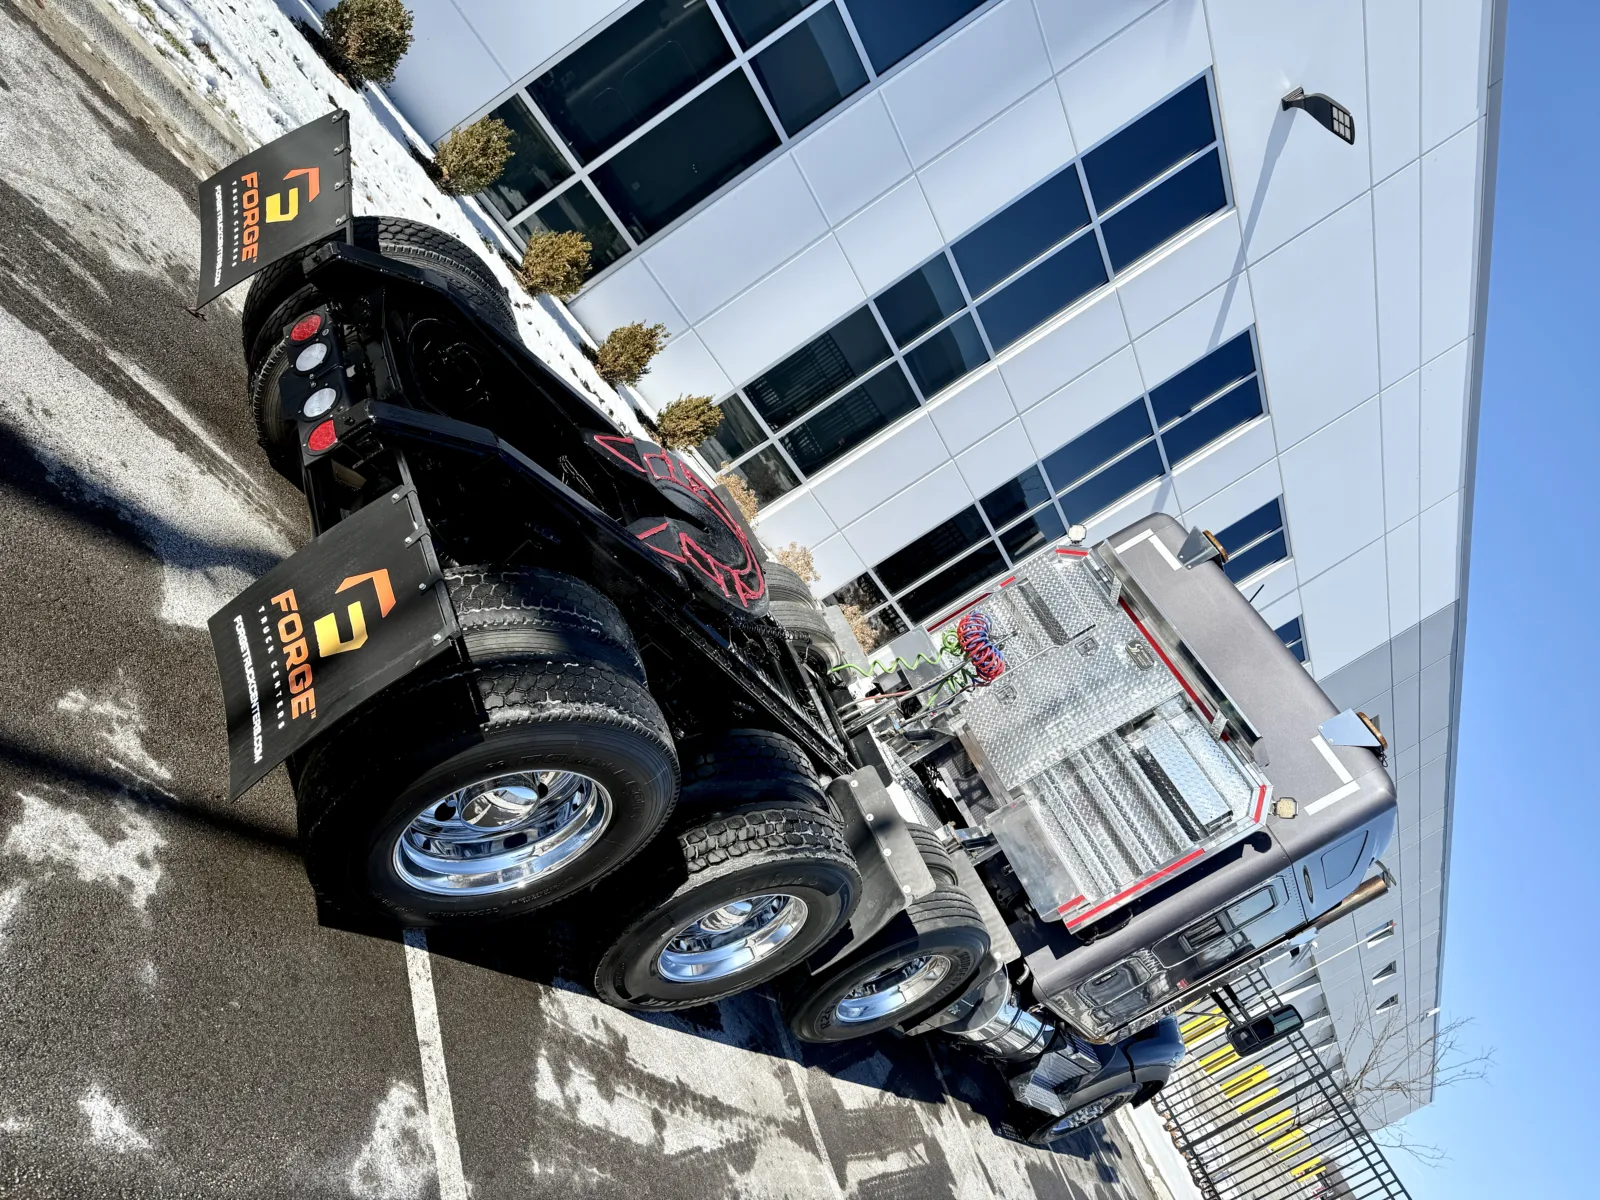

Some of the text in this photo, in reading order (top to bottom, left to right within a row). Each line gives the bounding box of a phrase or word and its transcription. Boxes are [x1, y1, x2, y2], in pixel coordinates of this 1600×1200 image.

[214, 185, 223, 287] FORGETRUCKCENTERS.COM
[241, 172, 259, 261] FORGE
[233, 614, 263, 763] FORGETRUCKCENTERS.COM
[258, 605, 286, 730] TRUCK CENTERS
[270, 588, 315, 720] FORGE
